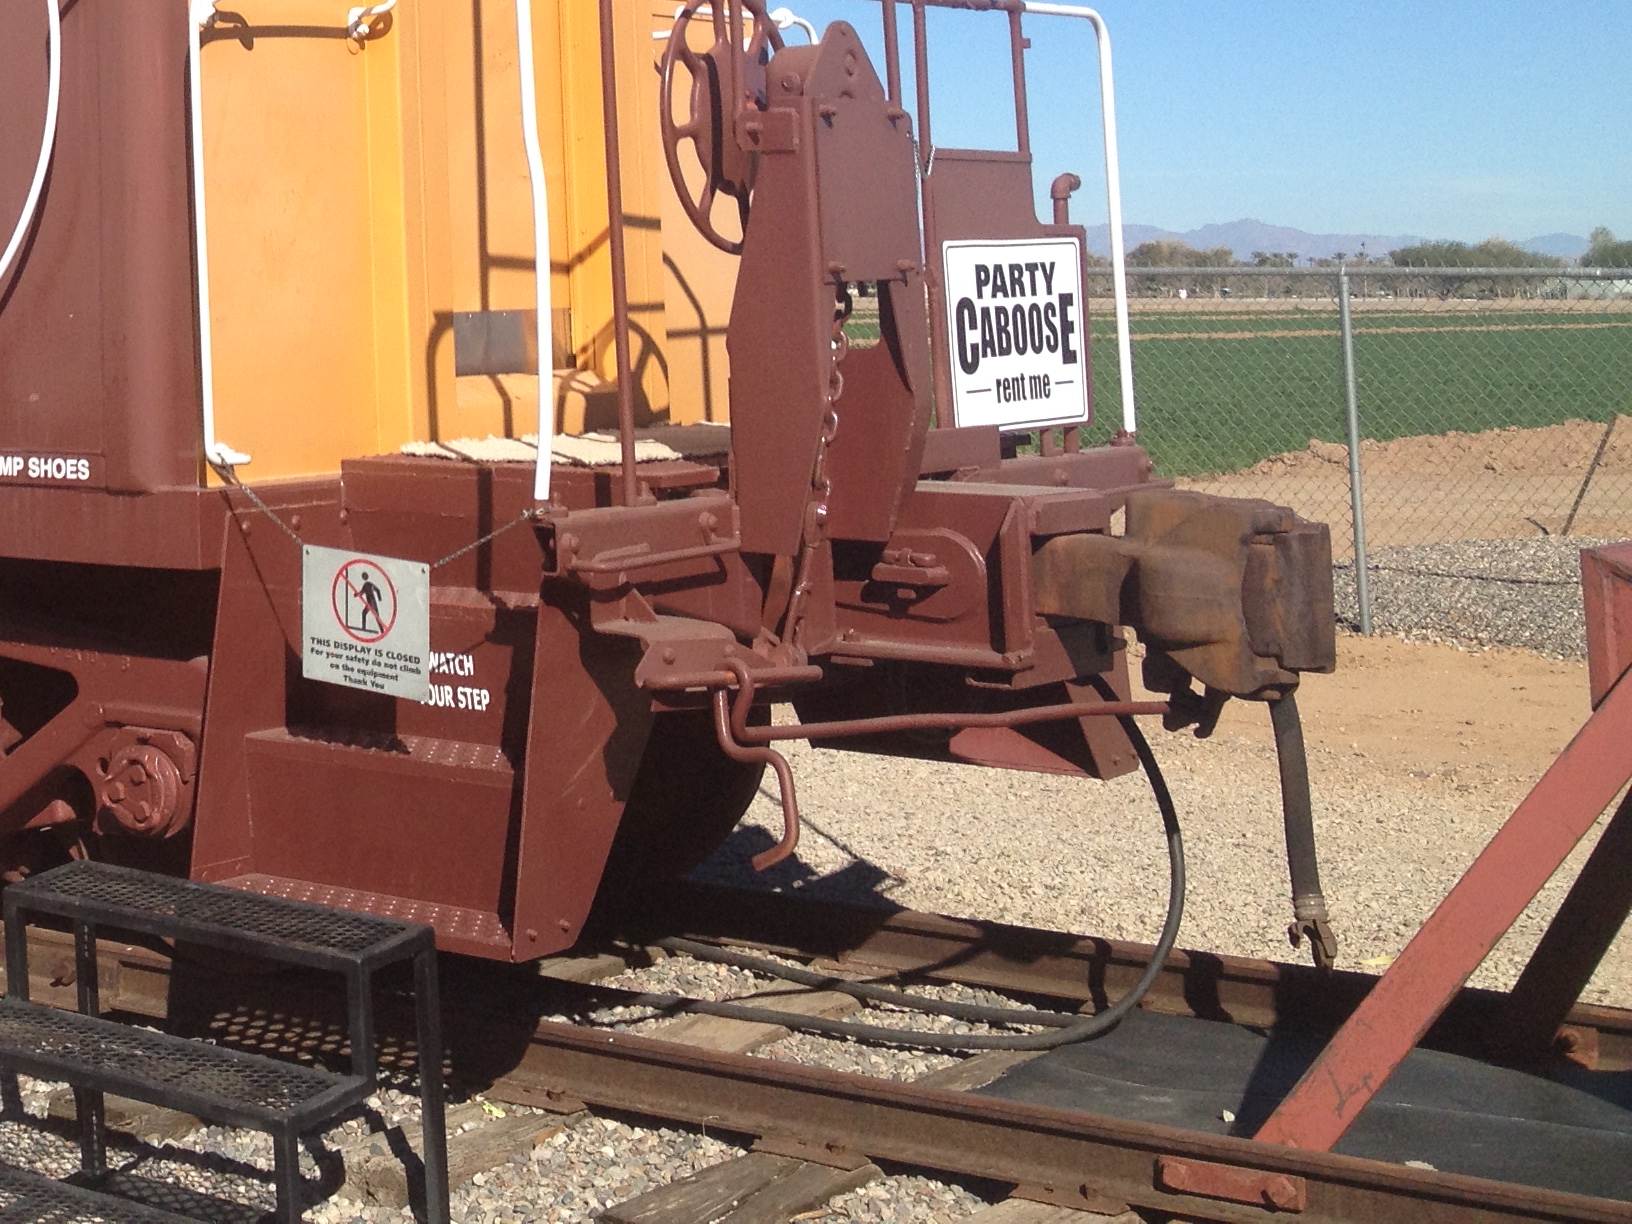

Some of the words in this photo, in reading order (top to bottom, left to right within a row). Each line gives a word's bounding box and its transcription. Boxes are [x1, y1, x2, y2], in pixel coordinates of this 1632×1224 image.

[975, 261, 1056, 299] PARTY
[956, 292, 1078, 375] CABOOSE
[996, 373, 1027, 403] rent
[1029, 373, 1051, 400] me
[28, 457, 90, 480] SHOES
[310, 636, 331, 647] THIS
[374, 648, 383, 657] IS
[385, 650, 421, 665] CLOSED
[310, 647, 324, 655] For
[326, 651, 343, 659] your
[345, 652, 370, 666] safety
[371, 659, 382, 667] do
[384, 662, 398, 670] not
[399, 664, 421, 675] climb
[342, 664, 354, 672] the
[356, 668, 399, 682] equipment
[343, 674, 368, 686] Thank
[370, 679, 385, 690] You
[421, 683, 456, 708] OUR
[457, 686, 490, 711] STEP
